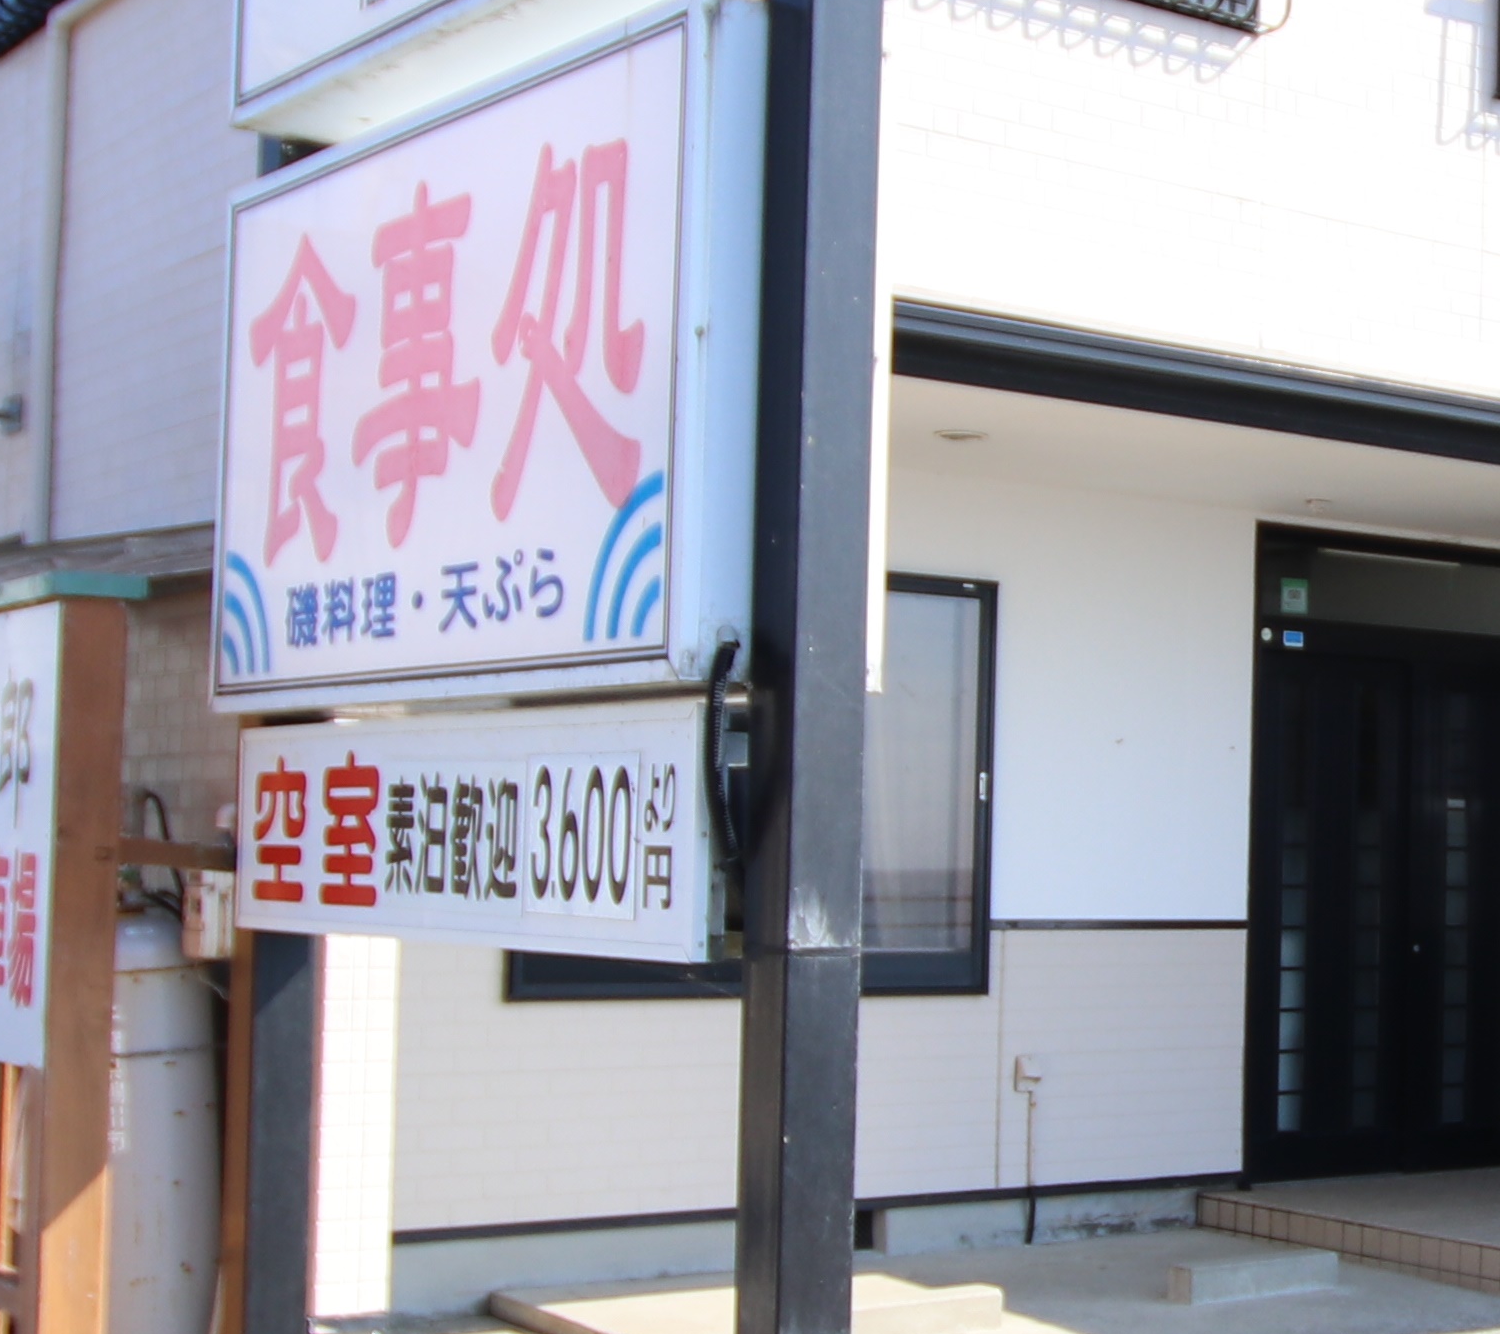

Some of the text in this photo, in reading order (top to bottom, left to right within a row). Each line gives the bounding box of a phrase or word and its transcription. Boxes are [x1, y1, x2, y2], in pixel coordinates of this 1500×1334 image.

[250, 138, 645, 567] 食事処
[285, 547, 565, 648] 磯料理・天ぷら
[252, 749, 381, 907] 空室
[384, 771, 519, 901] 素泊歓迎
